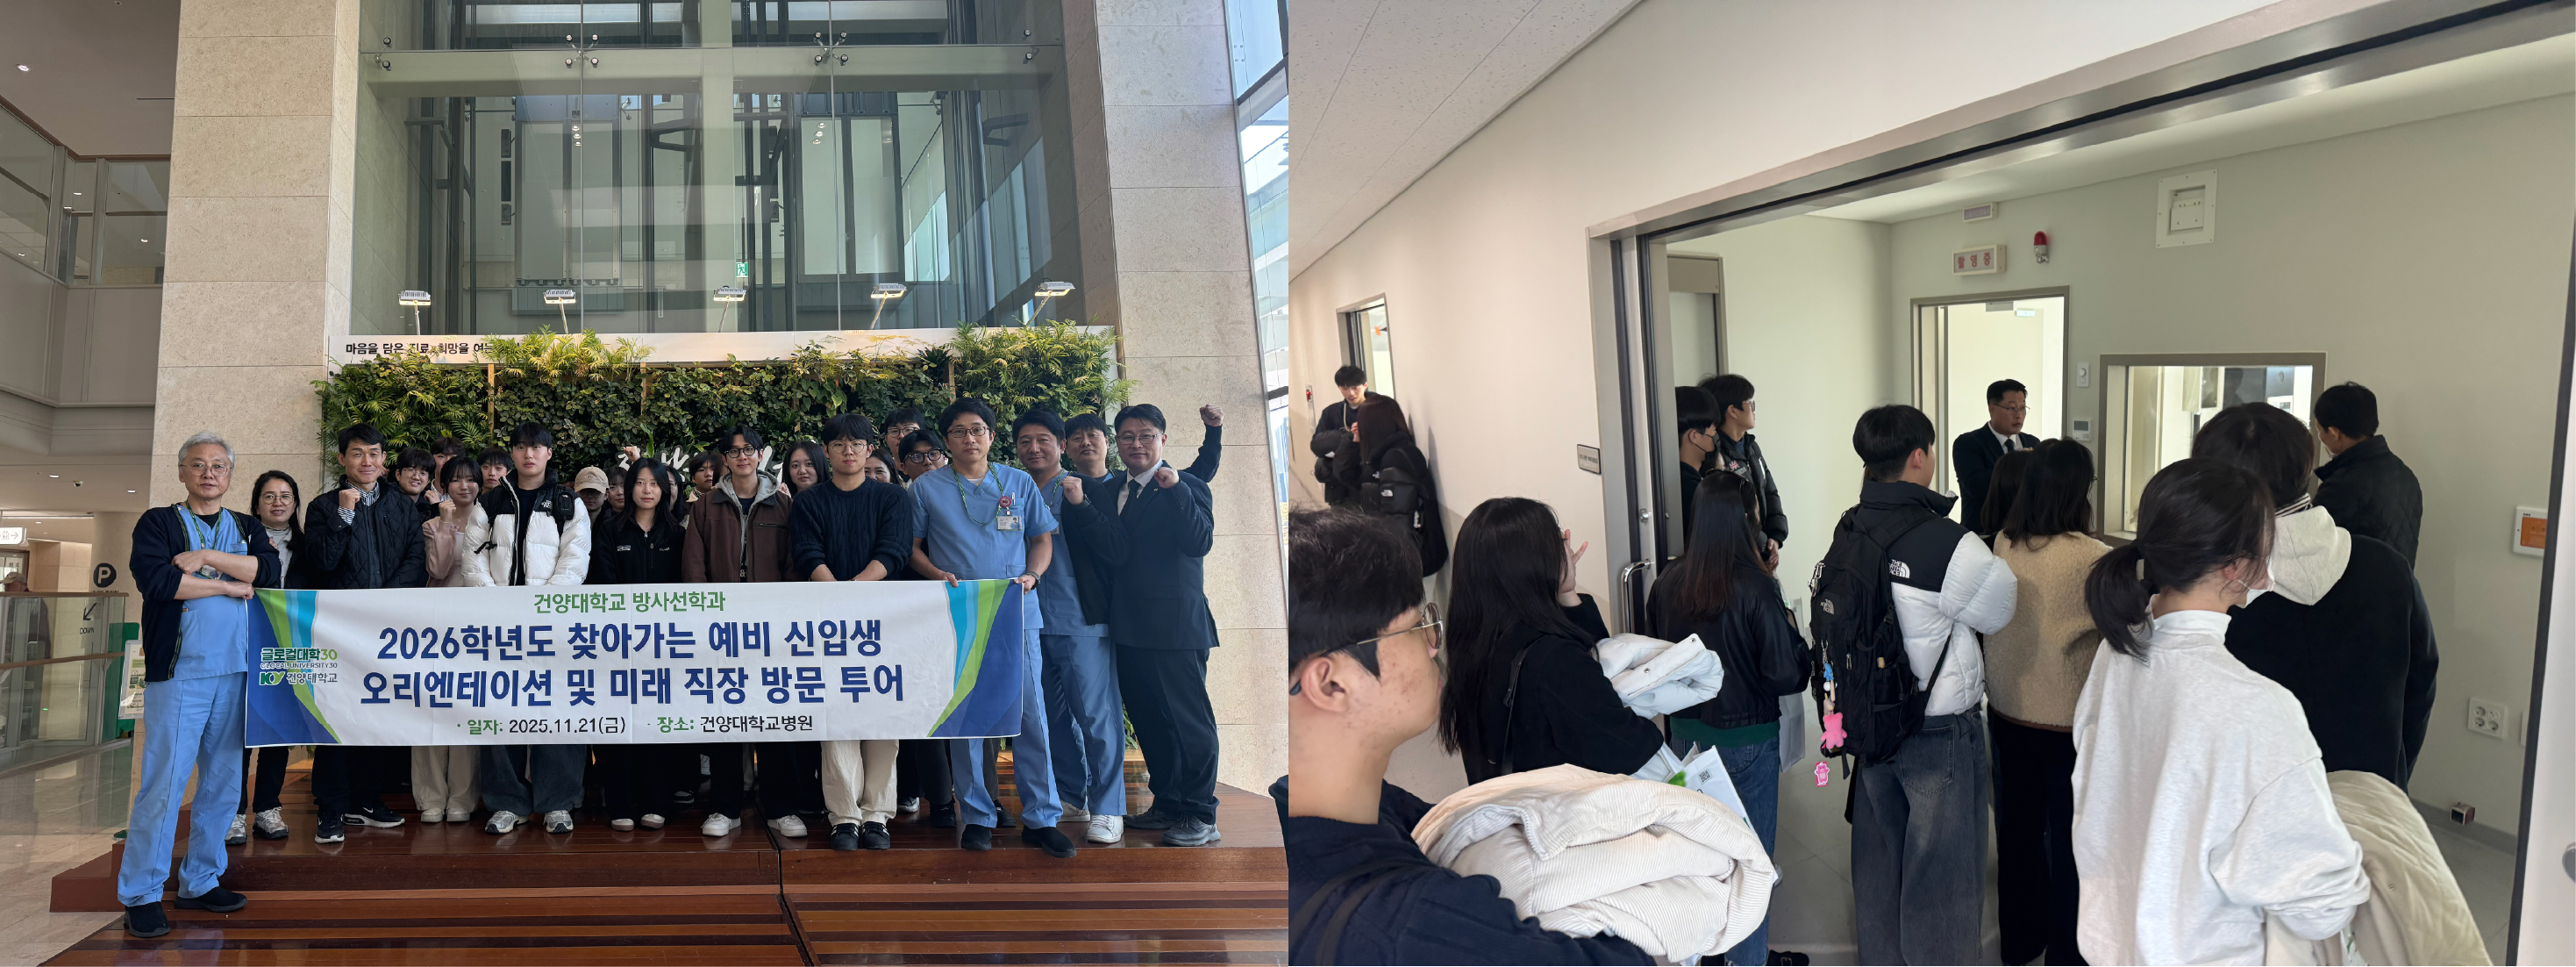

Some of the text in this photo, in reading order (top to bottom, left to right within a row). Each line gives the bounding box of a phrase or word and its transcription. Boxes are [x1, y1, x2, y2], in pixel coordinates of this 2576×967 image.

[346, 342, 379, 355] 마음을
[382, 342, 404, 355] 담은
[438, 342, 469, 355] 희망을
[533, 591, 726, 613] 건양대학교 방사선학과
[377, 619, 881, 661] 2026학년도 찾아가는 예비 신입생
[261, 648, 338, 662] 글로컬대학30
[287, 672, 338, 684] 건양대학교
[360, 664, 903, 709] 오리엔테이션 및 미래 직장 방문 투어
[467, 715, 813, 735] 일자: 2025.11.21(금) 장소: 건양대학교병원
